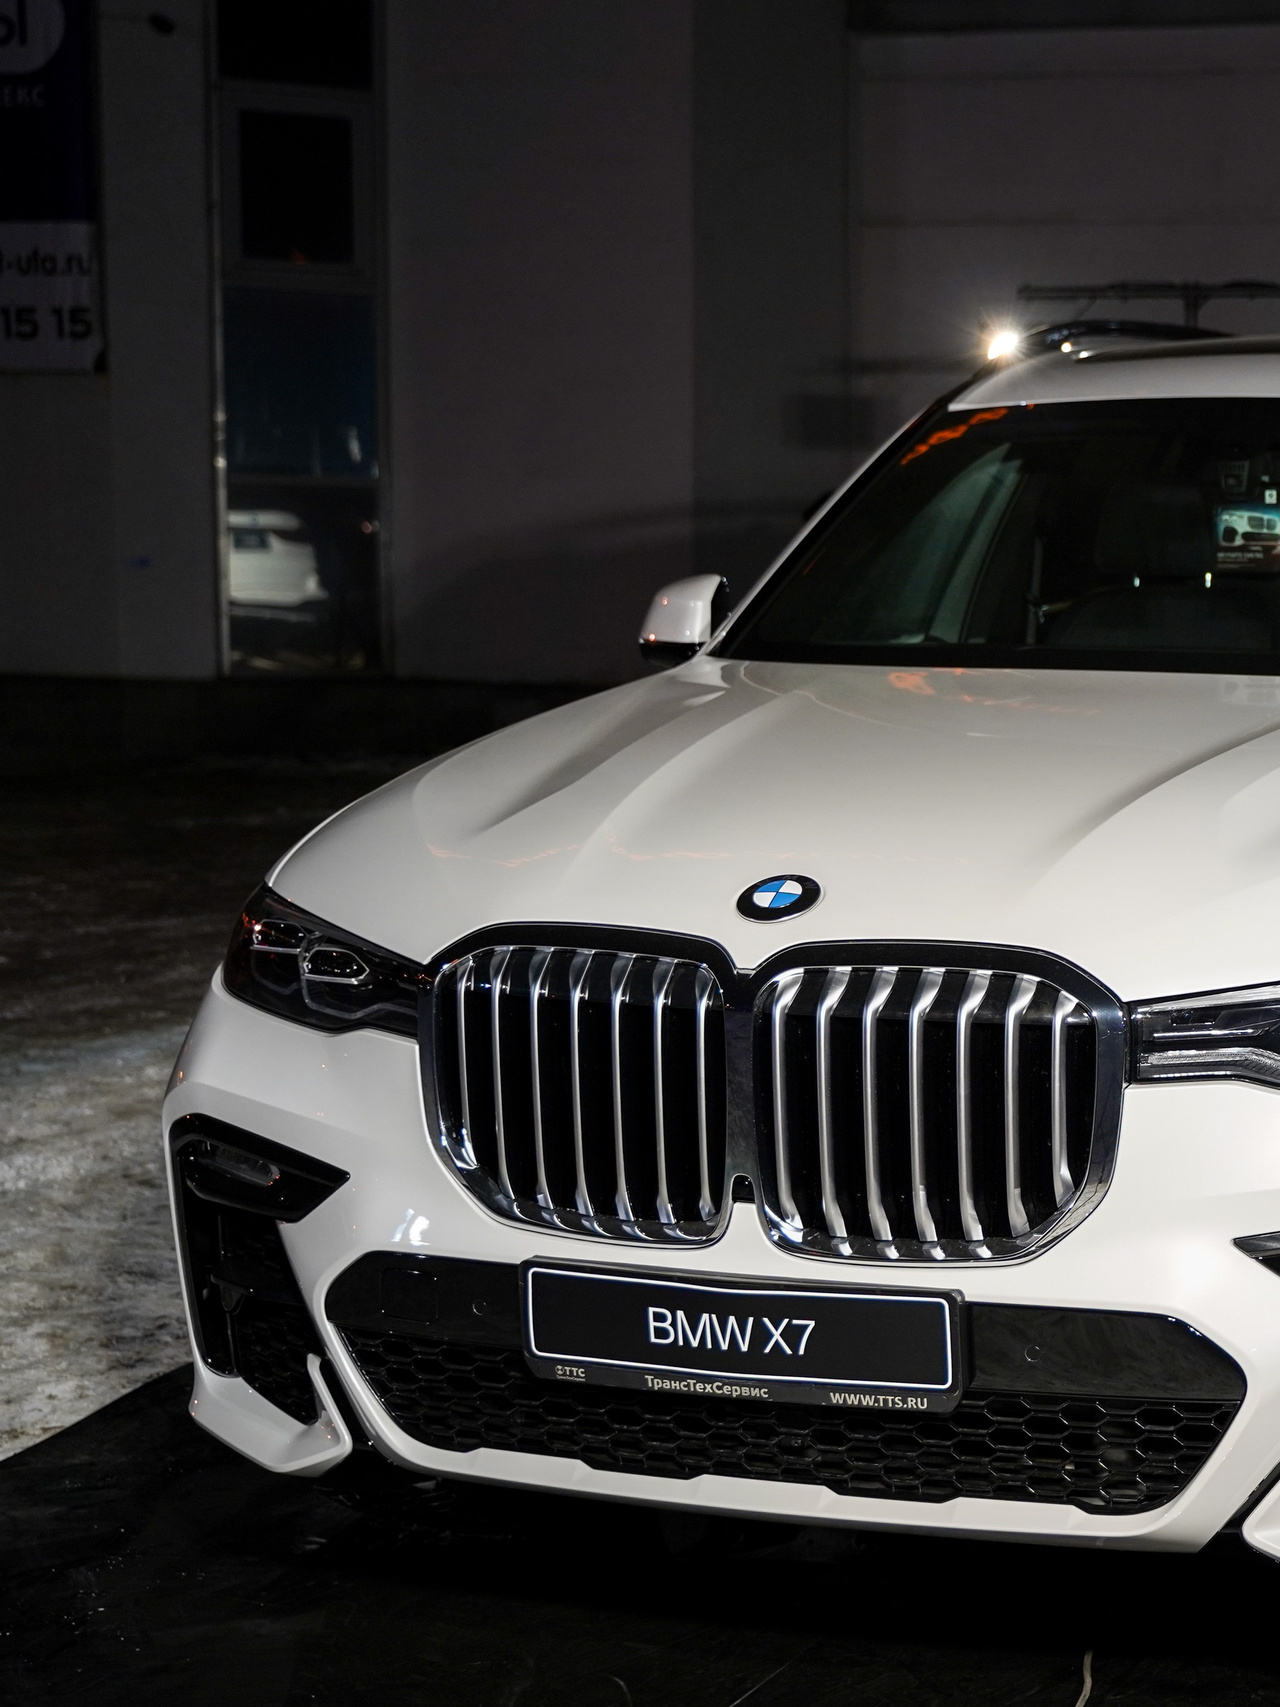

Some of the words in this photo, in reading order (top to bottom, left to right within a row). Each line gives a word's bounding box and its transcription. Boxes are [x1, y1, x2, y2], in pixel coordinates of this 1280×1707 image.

[0, 306, 39, 340] 15
[51, 306, 93, 341] 15
[648, 1306, 754, 1352] BMW
[762, 1317, 816, 1356] X7
[645, 1375, 769, 1398] ТрансТехСервис
[829, 1392, 928, 1410] WWW.TTS.RU
